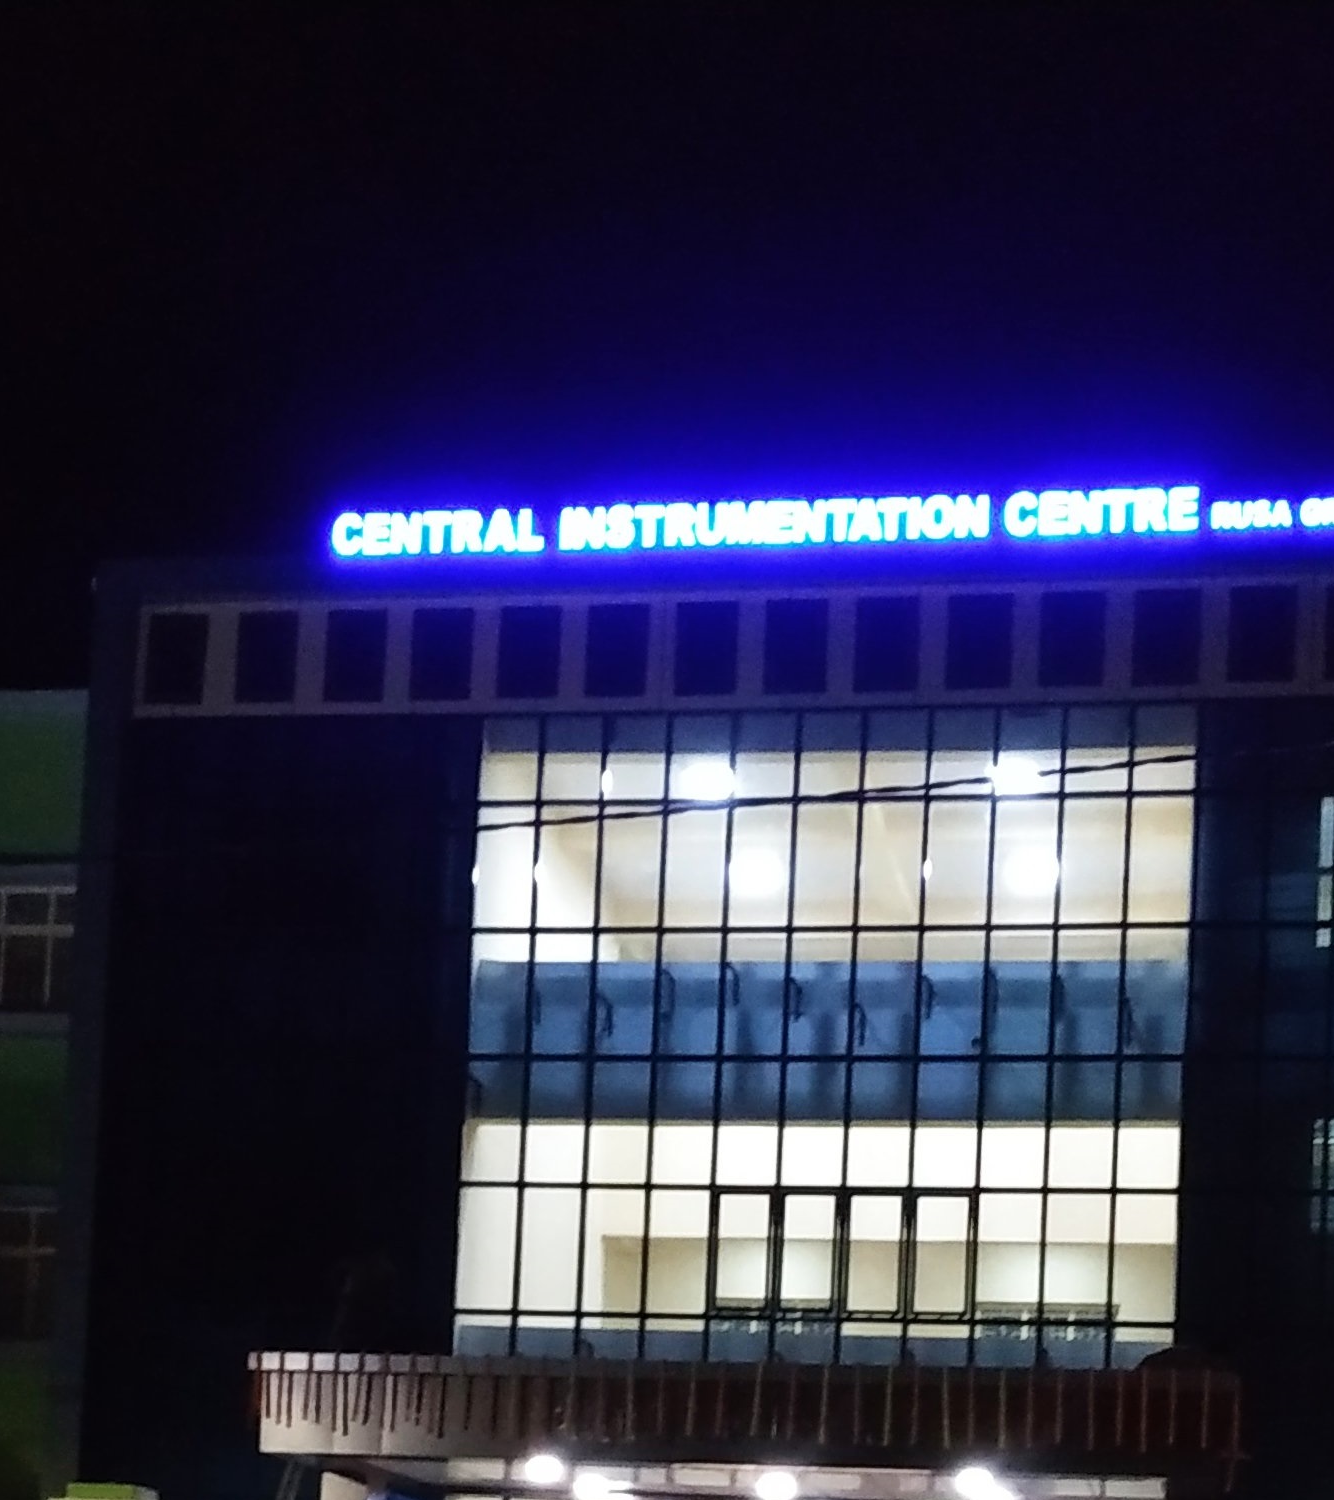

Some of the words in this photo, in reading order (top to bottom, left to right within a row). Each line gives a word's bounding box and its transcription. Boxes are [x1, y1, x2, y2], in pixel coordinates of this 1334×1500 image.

[331, 508, 545, 557] CENTRAL
[558, 495, 992, 551] INSTRUMENTATION
[1002, 486, 1200, 538] CENTRE
[1209, 498, 1294, 531] RUSA
